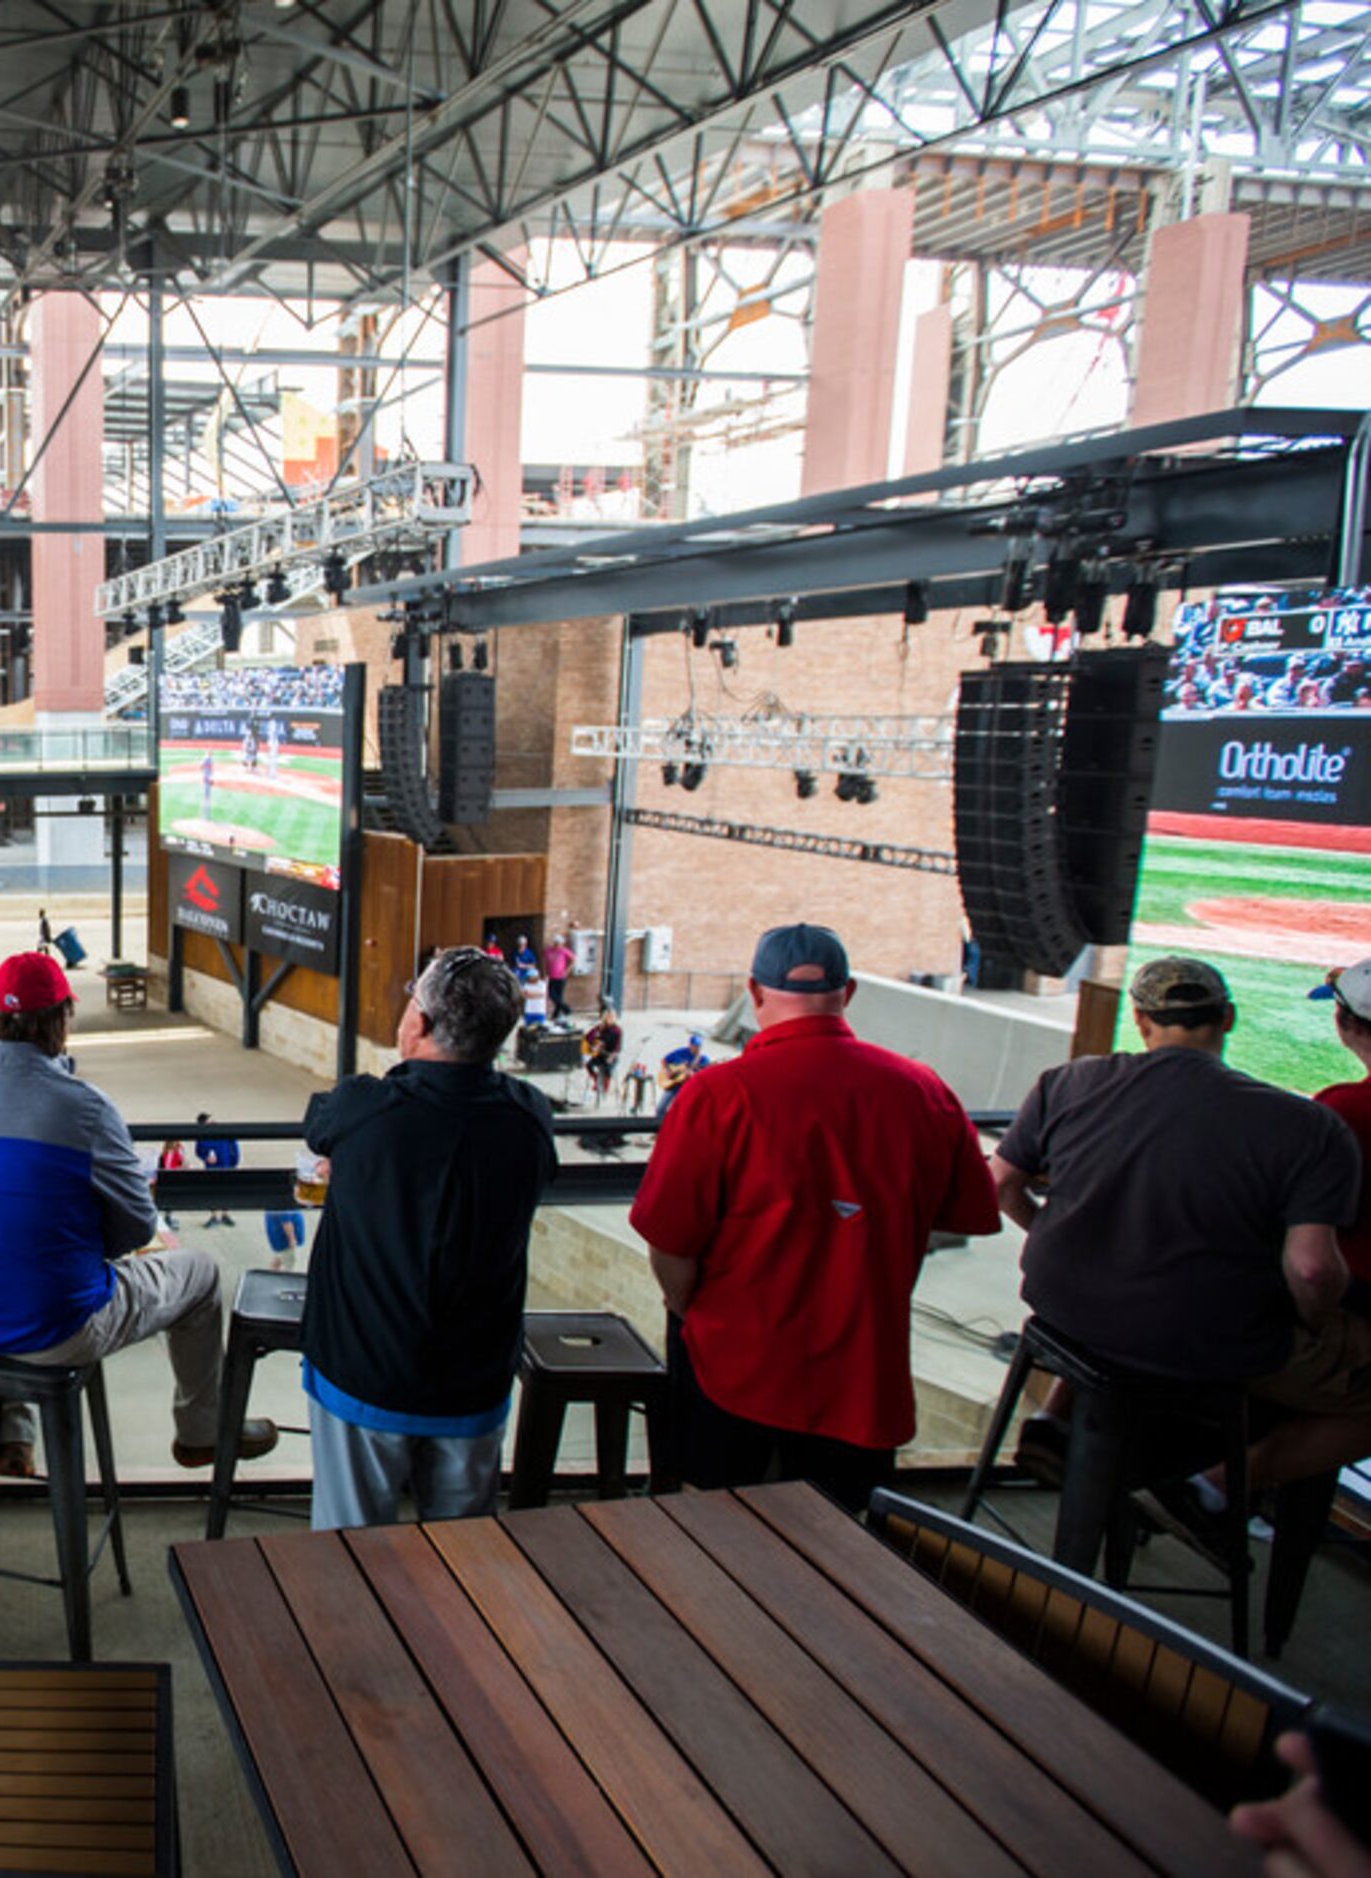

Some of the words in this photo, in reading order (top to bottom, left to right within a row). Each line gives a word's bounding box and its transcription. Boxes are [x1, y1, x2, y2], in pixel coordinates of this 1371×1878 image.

[1245, 618, 1284, 636] BAL
[1308, 615, 1326, 635] 0
[253, 892, 332, 931] CHOCTAW
